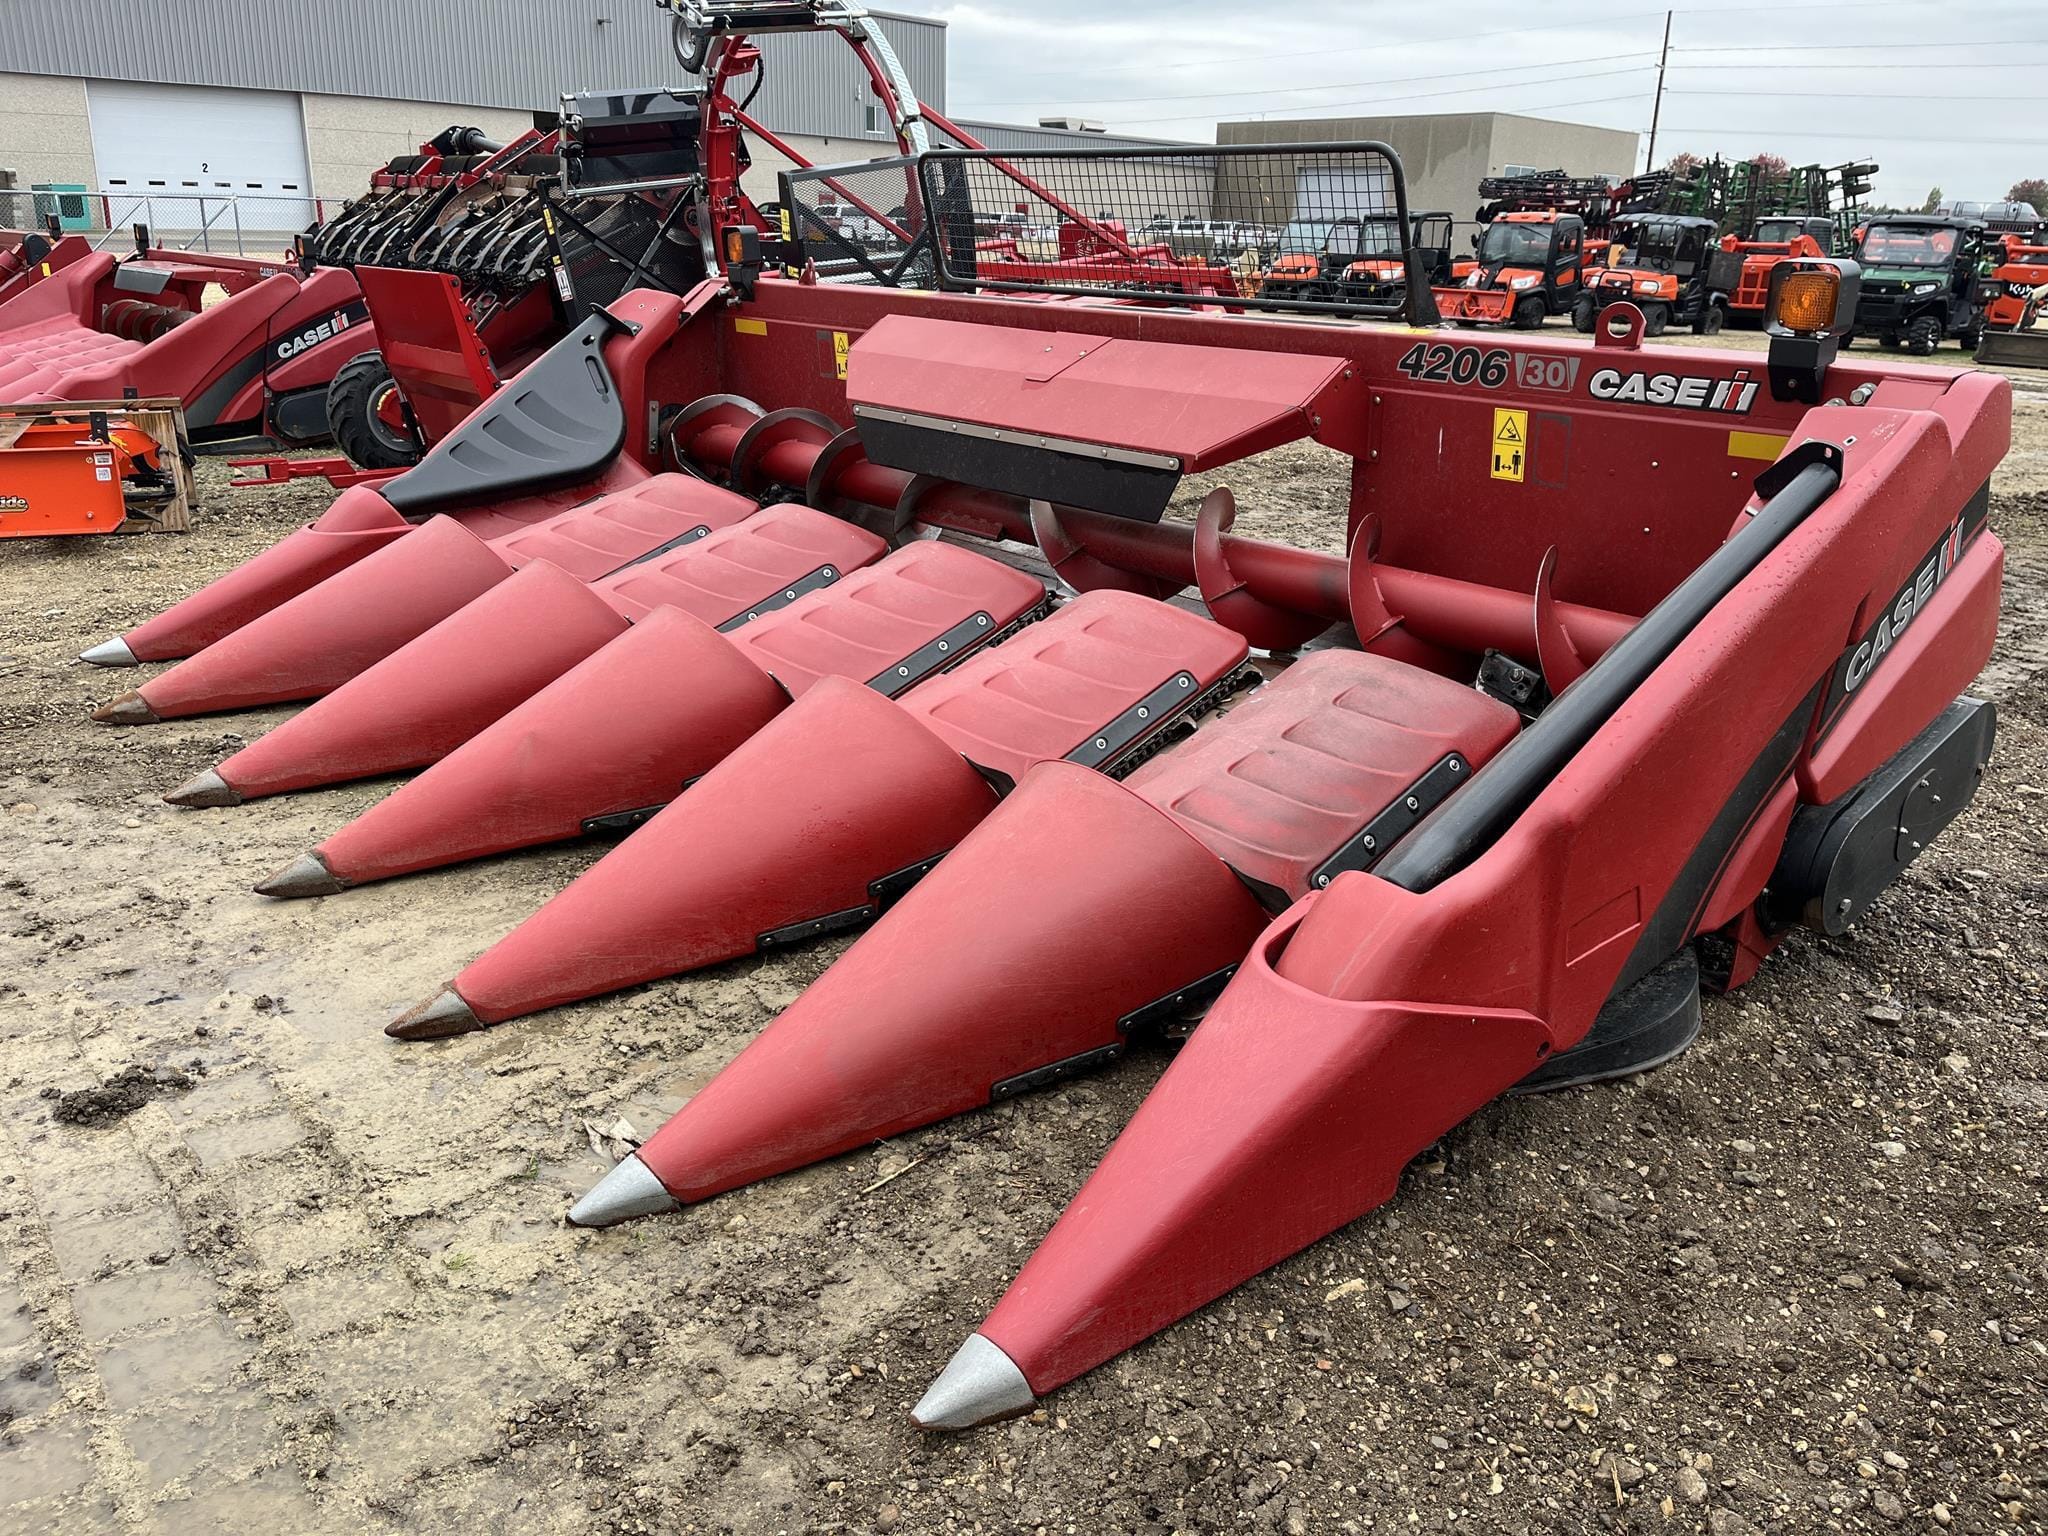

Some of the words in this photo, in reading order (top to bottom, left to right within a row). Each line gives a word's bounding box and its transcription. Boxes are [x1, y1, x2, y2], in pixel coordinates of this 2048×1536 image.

[201, 162, 209, 173] 2
[2008, 283, 2034, 295] Kub
[277, 322, 332, 359] CASE
[1397, 342, 1512, 389] 4206
[1526, 357, 1568, 388] 30
[1589, 369, 1712, 407] CASE
[0, 495, 27, 508] ide
[1845, 555, 1937, 692] CASE
